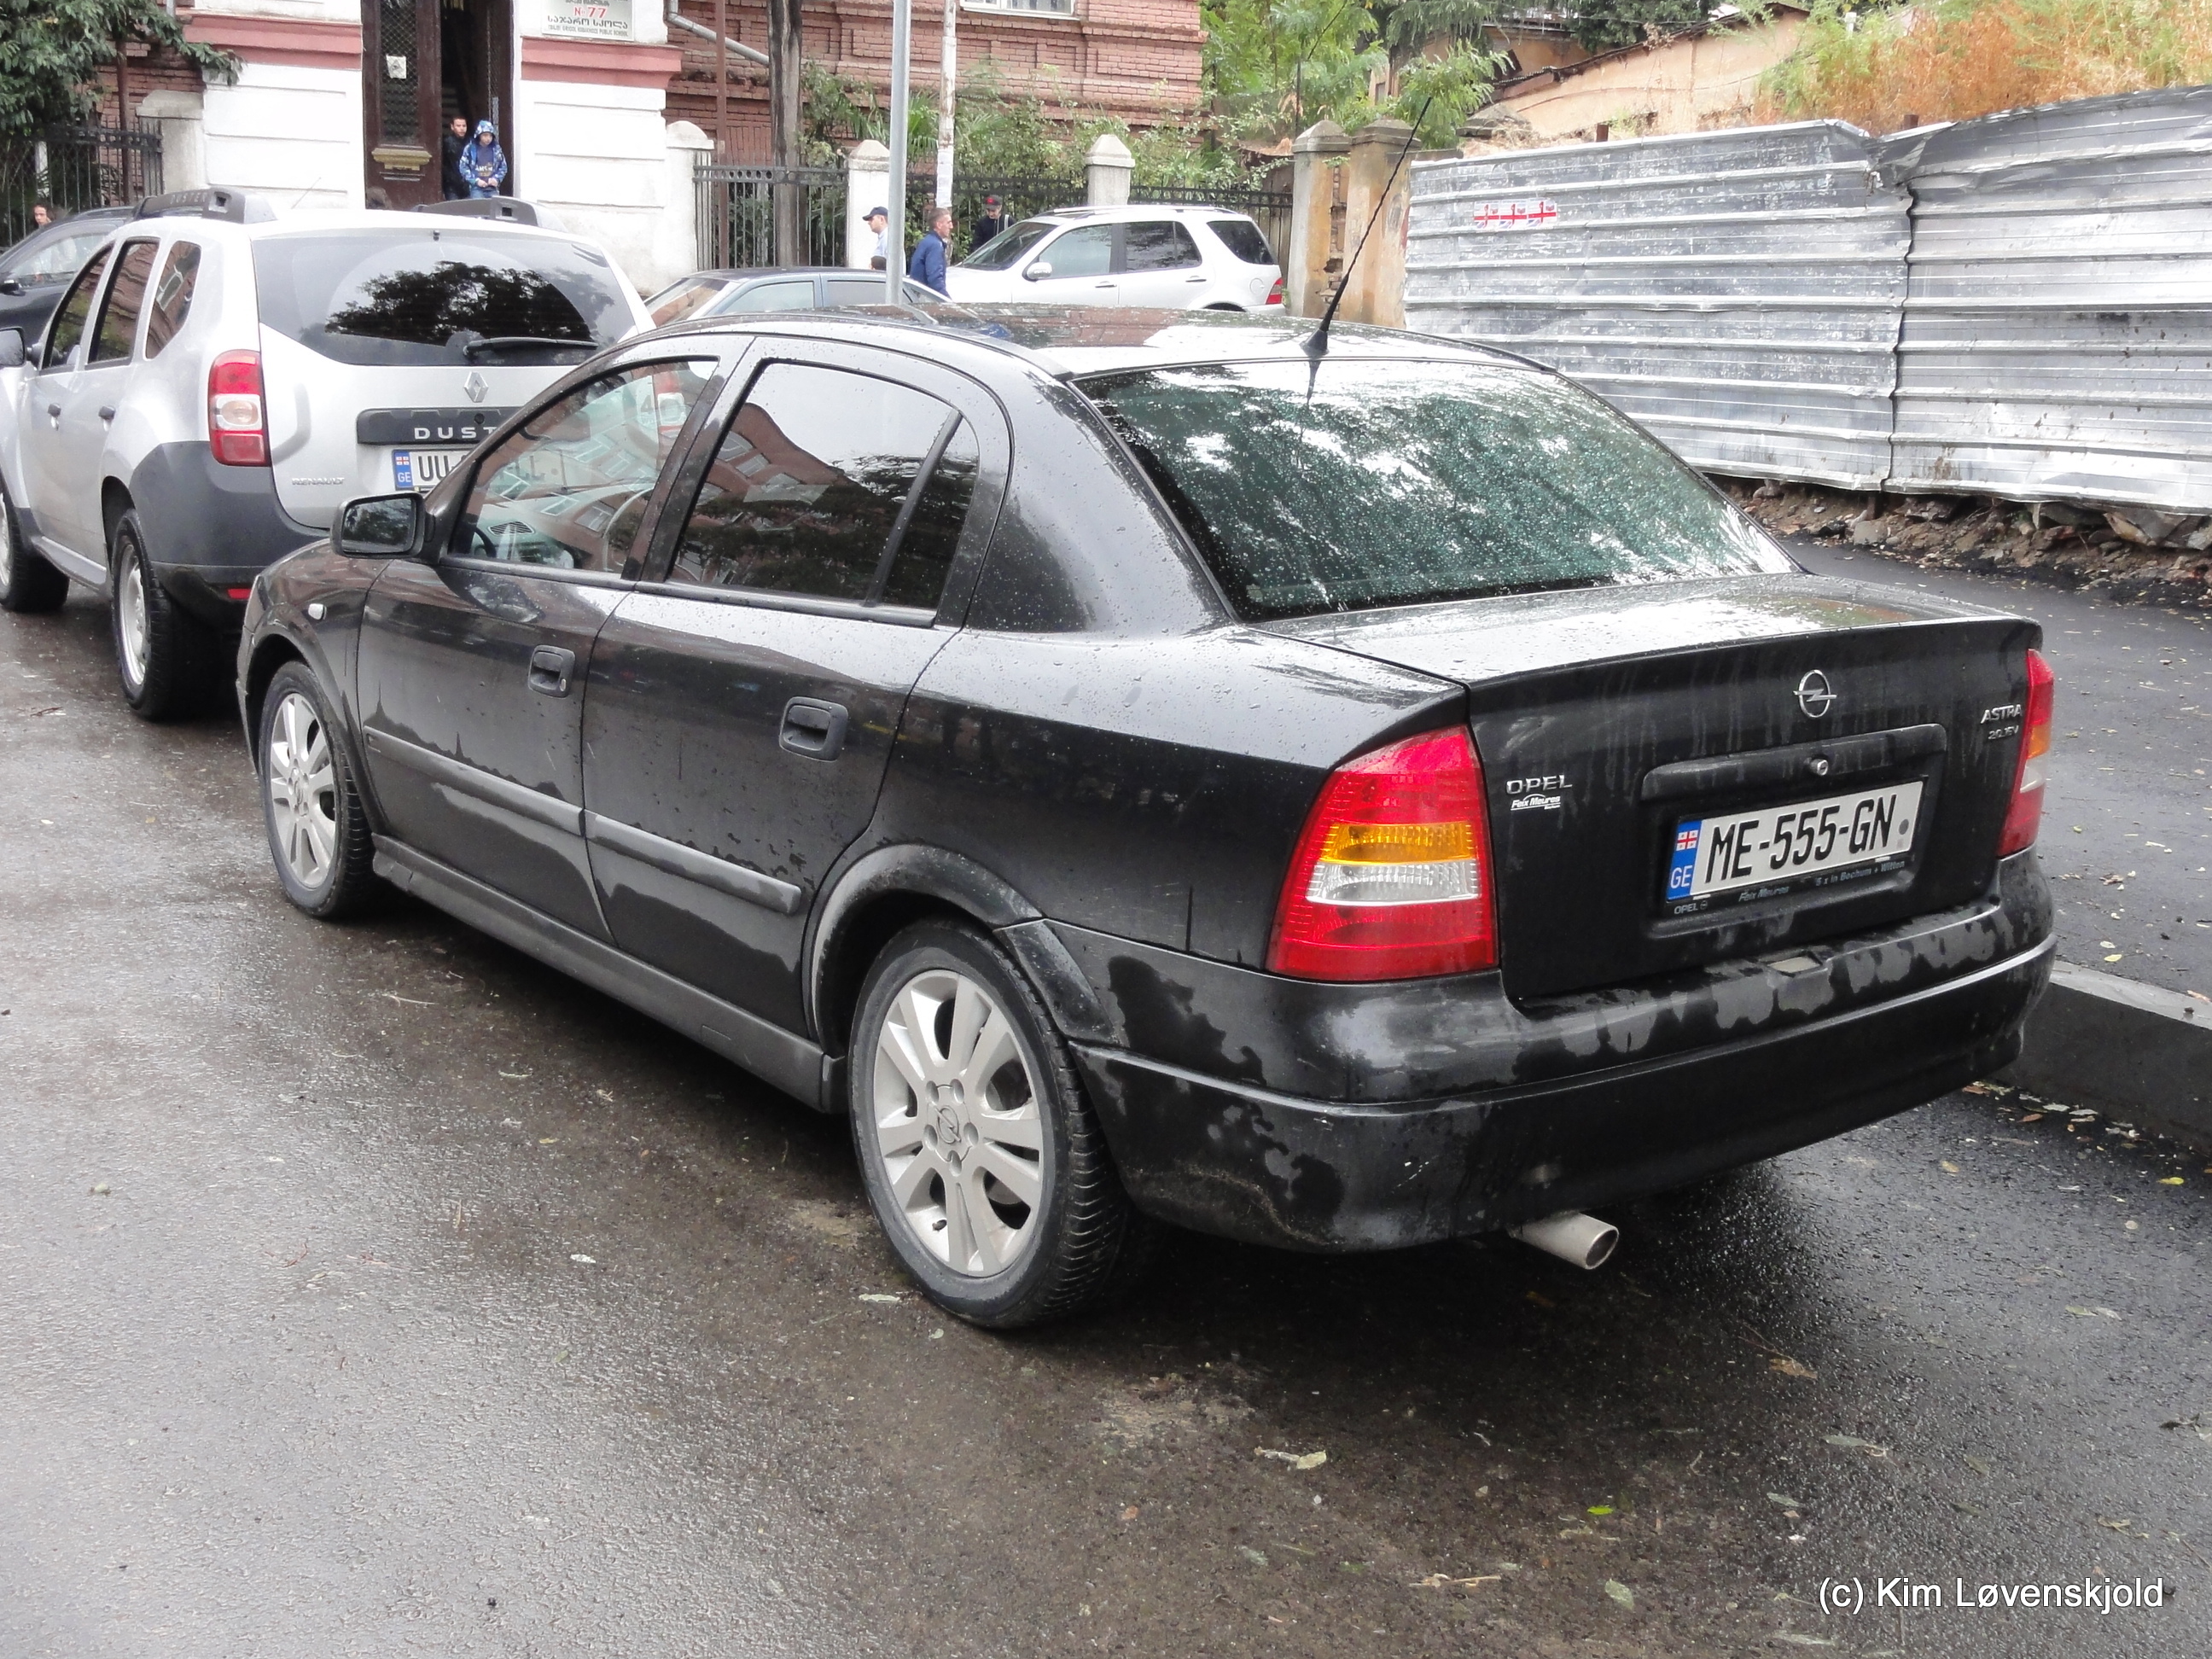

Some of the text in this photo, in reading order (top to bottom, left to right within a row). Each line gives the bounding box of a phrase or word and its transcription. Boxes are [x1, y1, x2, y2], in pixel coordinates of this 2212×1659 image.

[587, 7, 607, 18] 77
[592, 19, 628, 30] სკოლა
[414, 427, 497, 439] DUST
[291, 477, 345, 486] RENAULT
[398, 472, 411, 483] GE
[1980, 704, 2023, 725] ASTRA
[1506, 774, 1573, 795] OPEL
[1704, 794, 1898, 884] ME-555-GN
[1670, 864, 1693, 889] GE
[1840, 867, 1872, 881] Bochum
[1880, 860, 1906, 872] Witten
[1674, 903, 1699, 915] OPEL
